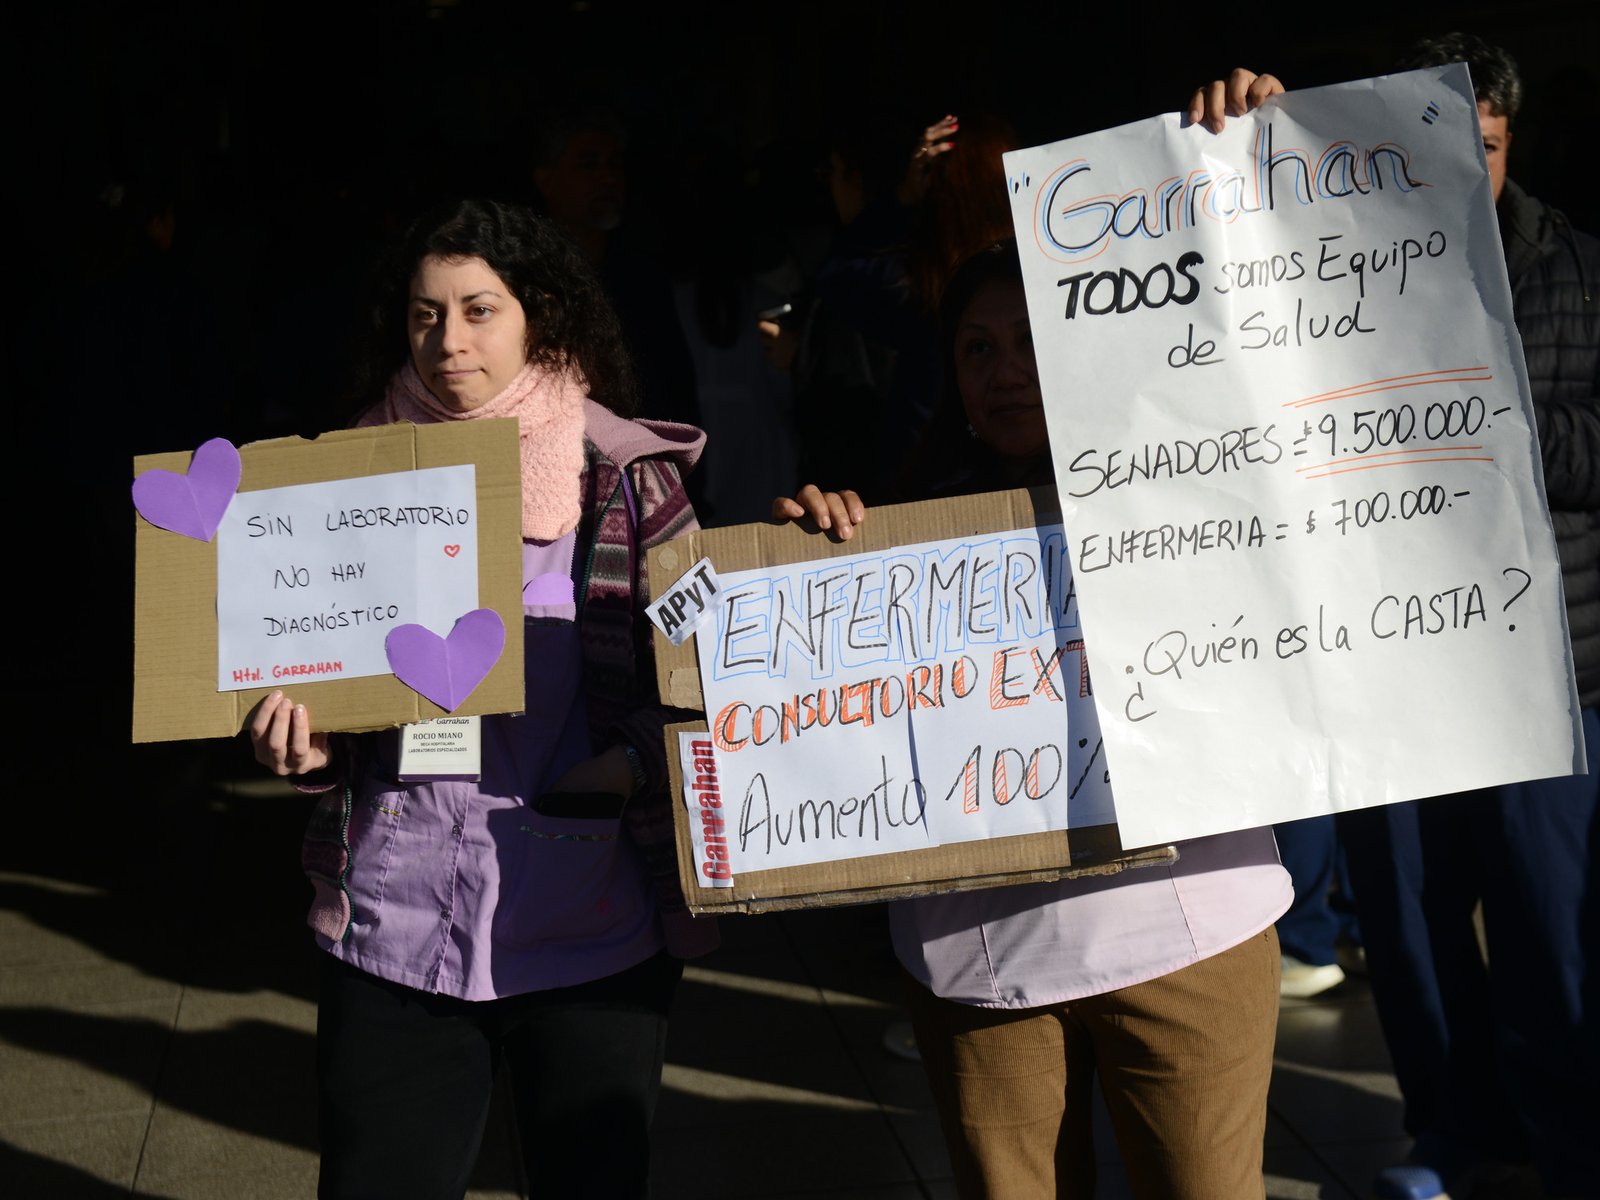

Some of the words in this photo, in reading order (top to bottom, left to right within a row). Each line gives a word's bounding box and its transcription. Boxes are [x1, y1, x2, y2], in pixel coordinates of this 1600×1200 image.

[1057, 251, 1204, 319] TODOS
[1214, 251, 1305, 294] somos
[1318, 231, 1447, 298] Equipo
[1168, 323, 1225, 368] de
[1240, 298, 1375, 350] Salud
[1069, 424, 1282, 497] SENADORES
[274, 565, 310, 590] NO
[331, 562, 366, 582] HAY
[657, 565, 718, 636] APyT
[272, 661, 342, 678] GARRAHAN
[713, 655, 979, 752] CONSULTORIO
[739, 754, 927, 854] Aumento
